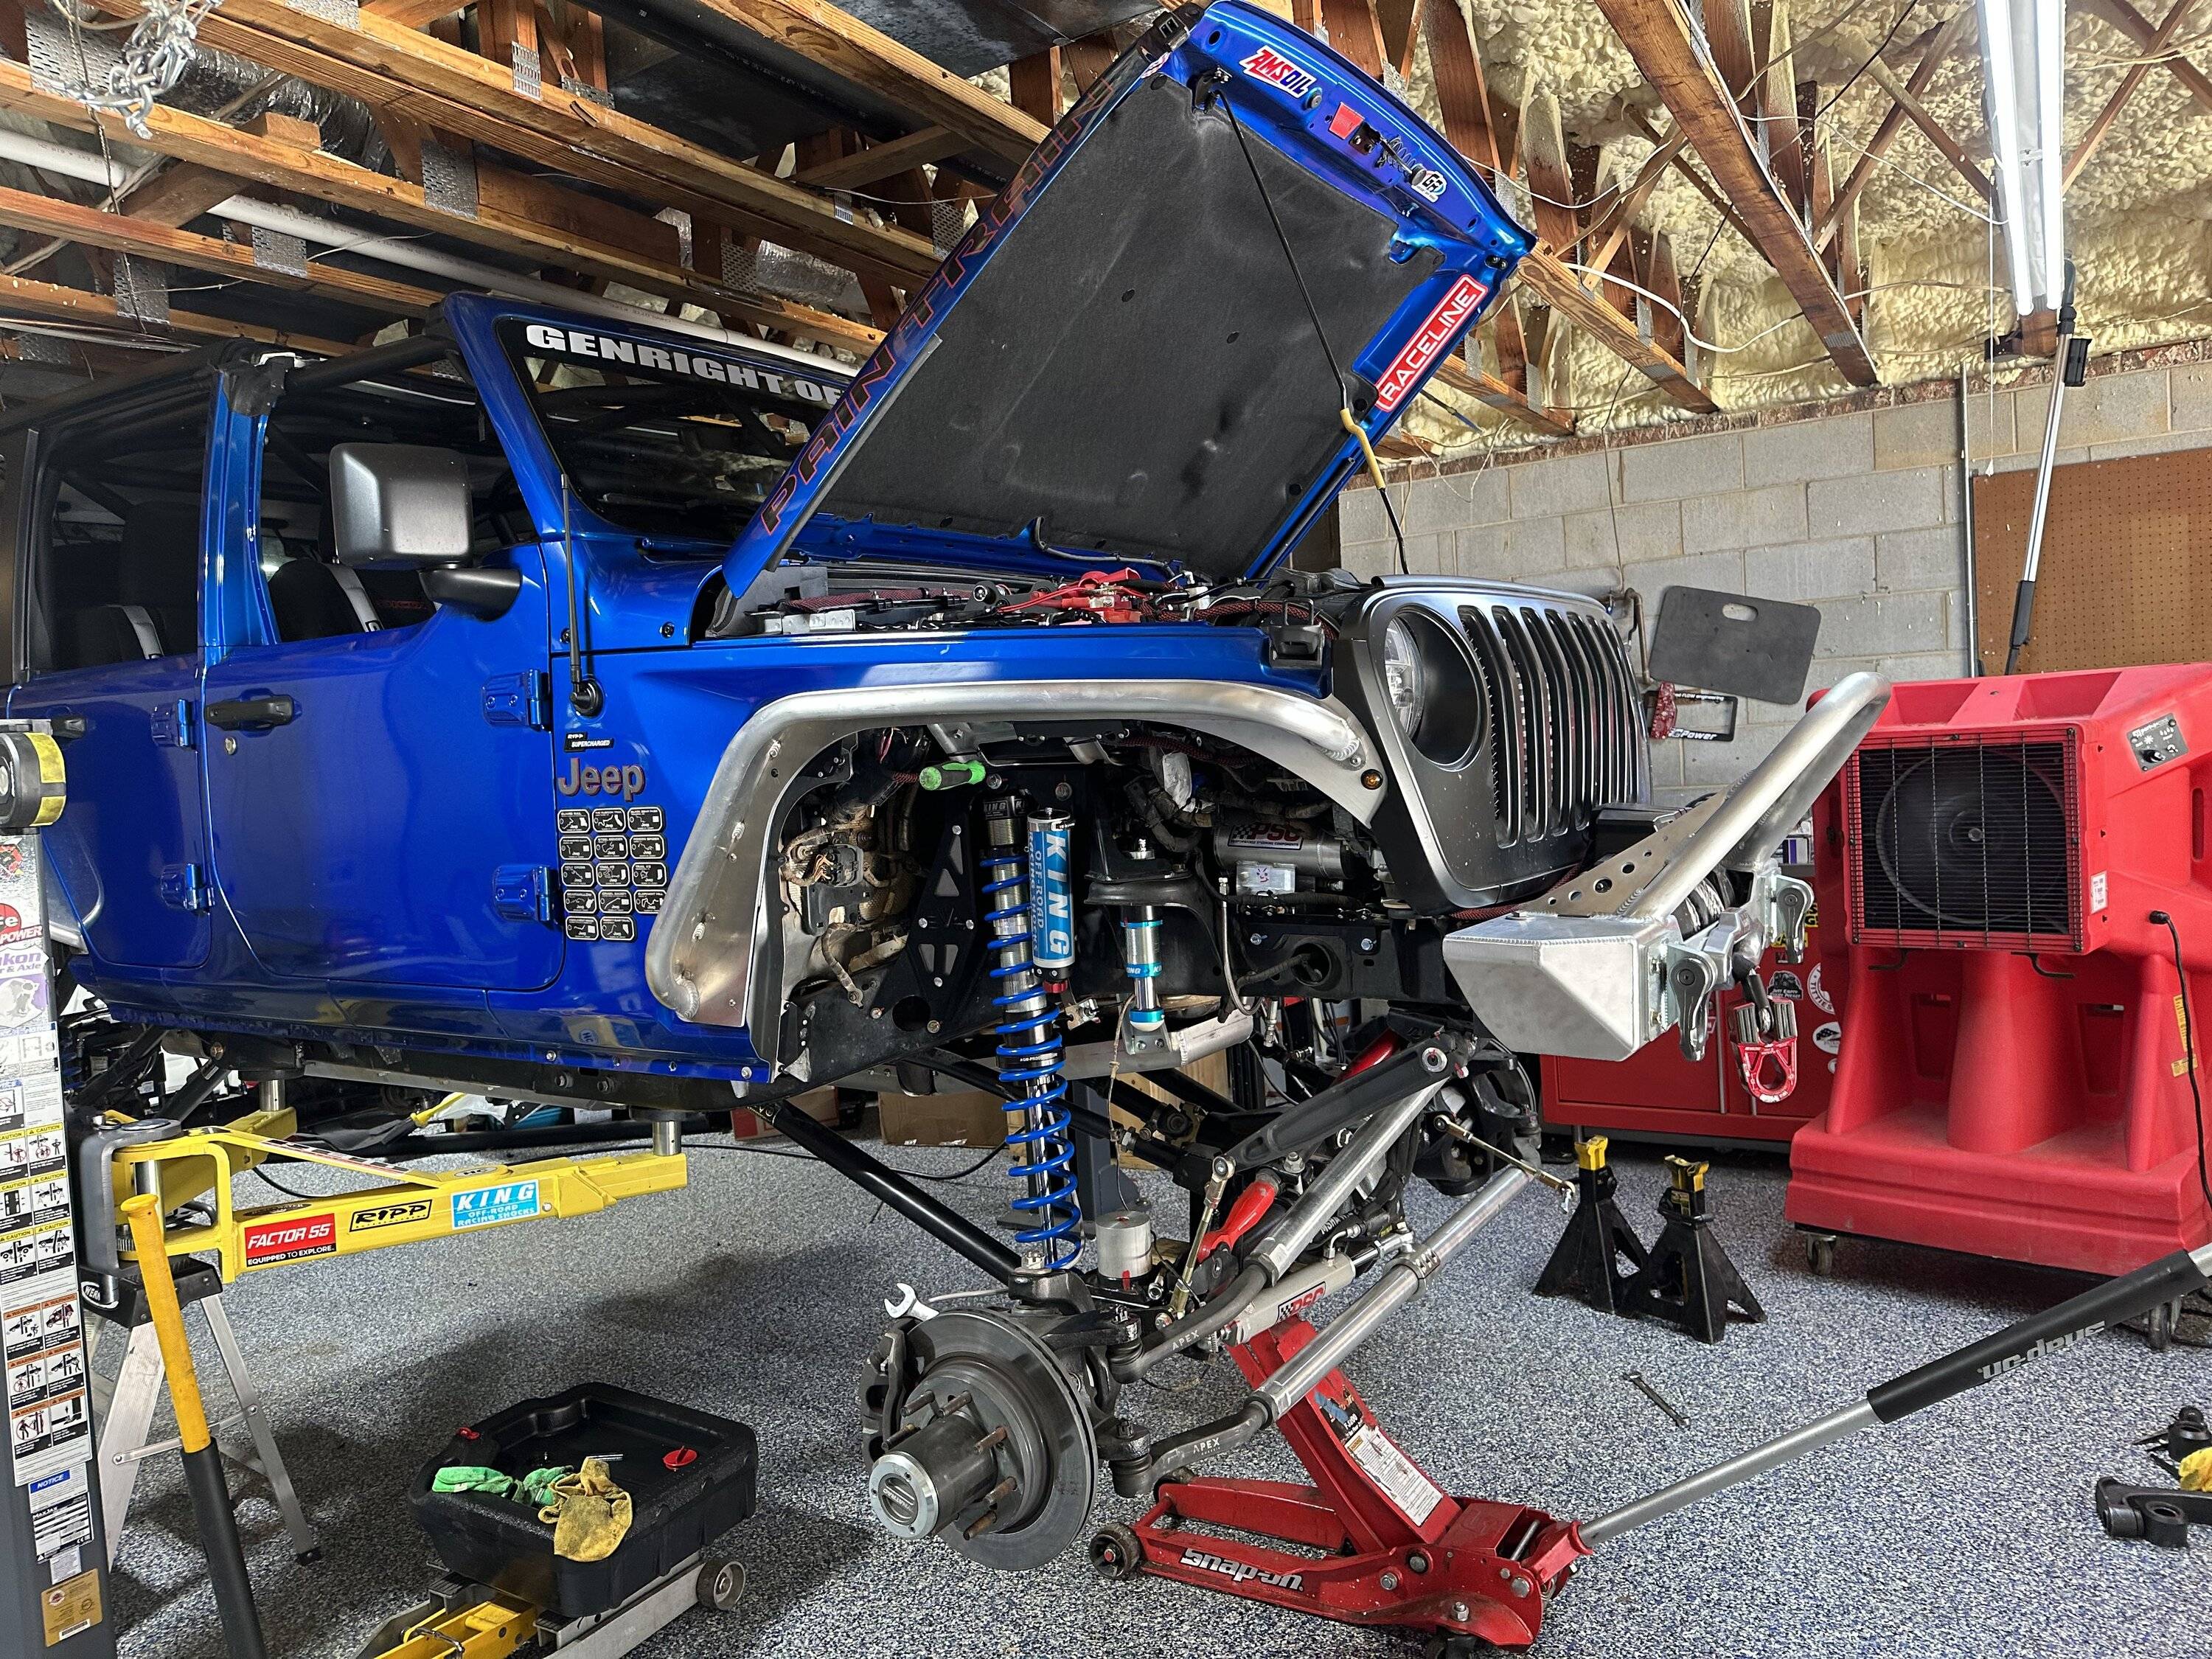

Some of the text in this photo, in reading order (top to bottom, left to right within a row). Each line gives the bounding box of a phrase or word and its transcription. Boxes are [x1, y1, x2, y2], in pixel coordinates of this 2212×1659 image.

[1245, 49, 1312, 94] AMSOIL
[761, 79, 1114, 535] PAIN TRAIN
[1380, 289, 1477, 402] RACELINE
[526, 324, 849, 406] GENRIGHT OF
[571, 740, 611, 748] SUPERCHARGED
[557, 757, 645, 802] Jeep
[1035, 850, 1044, 929] OFF-ROAD
[1046, 832, 1070, 956] KING
[0, 926, 43, 944] POWER
[17, 963, 41, 971] Axle
[36, 1124, 60, 1133] CAUTION
[1, 1181, 27, 1190] CAUTION
[41, 1172, 64, 1181] CAUTION
[457, 1183, 535, 1211] KING
[355, 1205, 427, 1224] RIPP
[457, 1208, 535, 1226] RACING SHOCKS
[468, 1204, 518, 1217] OFF-ROAD
[44, 1221, 69, 1231] CAUTION
[6, 1231, 31, 1240] CAUTION
[248, 1223, 331, 1250] FACTOR 55
[248, 1253, 286, 1265] EQUIPPED
[1172, 1329, 1200, 1351] APEX
[1193, 1437, 1220, 1454] APEX
[37, 1474, 65, 1489] NOTICE
[1180, 1548, 1302, 1590] Snap-on
